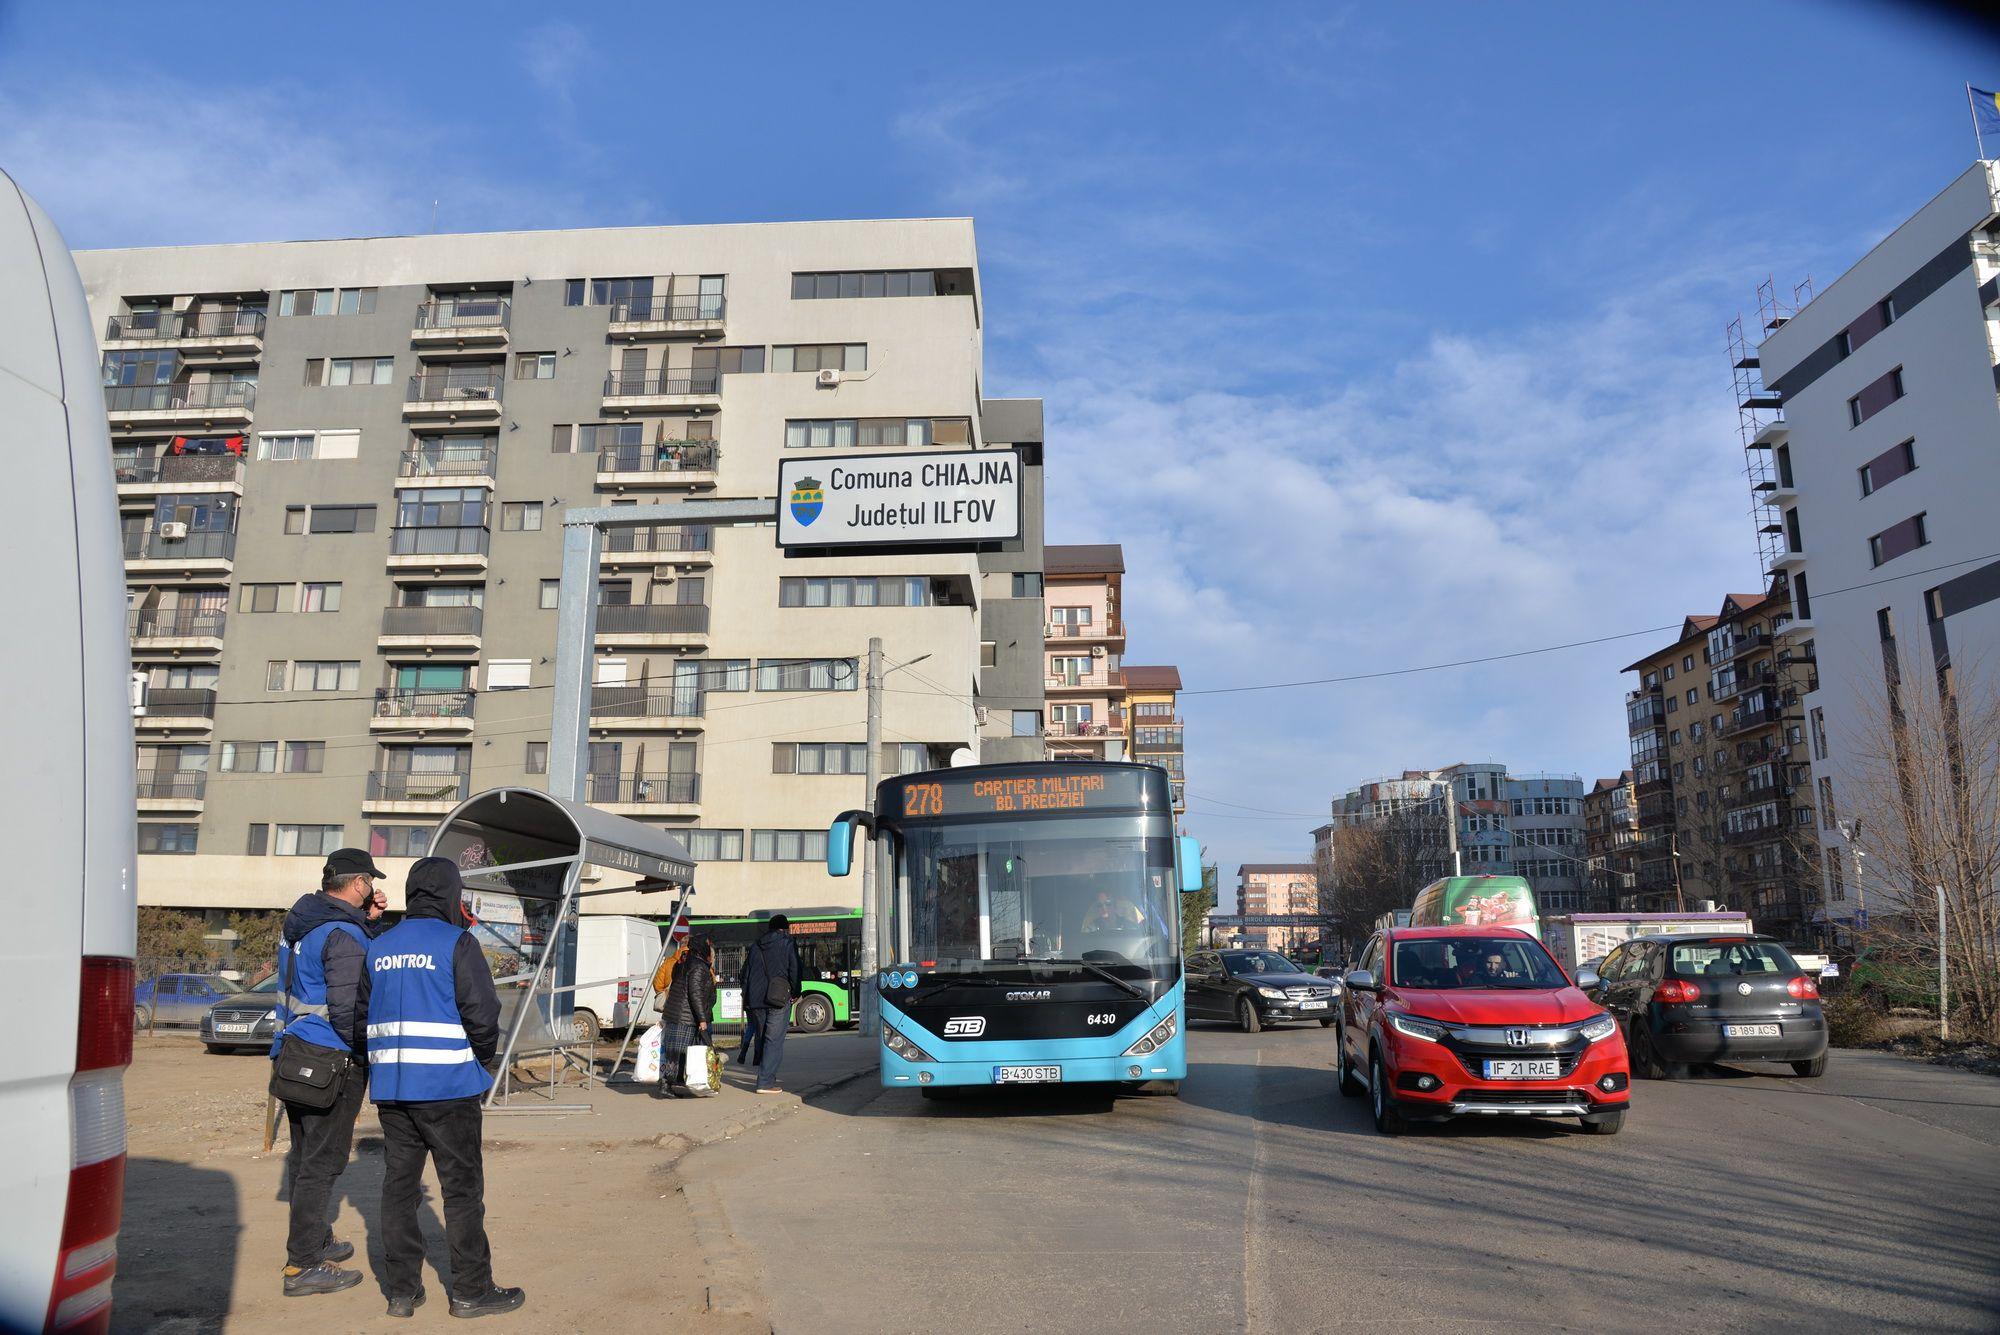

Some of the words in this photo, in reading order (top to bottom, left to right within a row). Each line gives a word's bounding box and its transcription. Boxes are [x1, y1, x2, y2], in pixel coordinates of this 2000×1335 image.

[831, 467, 912, 490] Comuna
[921, 461, 1013, 487] CHIAJNA
[847, 501, 925, 529] Județul
[934, 499, 996, 524] ILFOV
[974, 778, 1036, 797] CARTIER
[1042, 775, 1104, 793] MILITARI
[905, 783, 943, 816] 278
[996, 796, 1017, 811] BD.
[1023, 792, 1085, 810] PRECIZIEI
[374, 953, 436, 972] CONTROL
[1005, 990, 1051, 1001] OTOKAR
[944, 1019, 982, 1034] STB
[1087, 1013, 1116, 1025] 6430
[1729, 1026, 1737, 1036] B
[1740, 1026, 1755, 1036] 189
[1758, 1025, 1777, 1035] ACS
[1001, 1068, 1009, 1080] B
[1013, 1068, 1033, 1080] 430
[1035, 1067, 1058, 1079] STB
[1493, 1062, 1506, 1075] IF
[1510, 1062, 1523, 1075] 21
[1528, 1062, 1555, 1075] RAE
